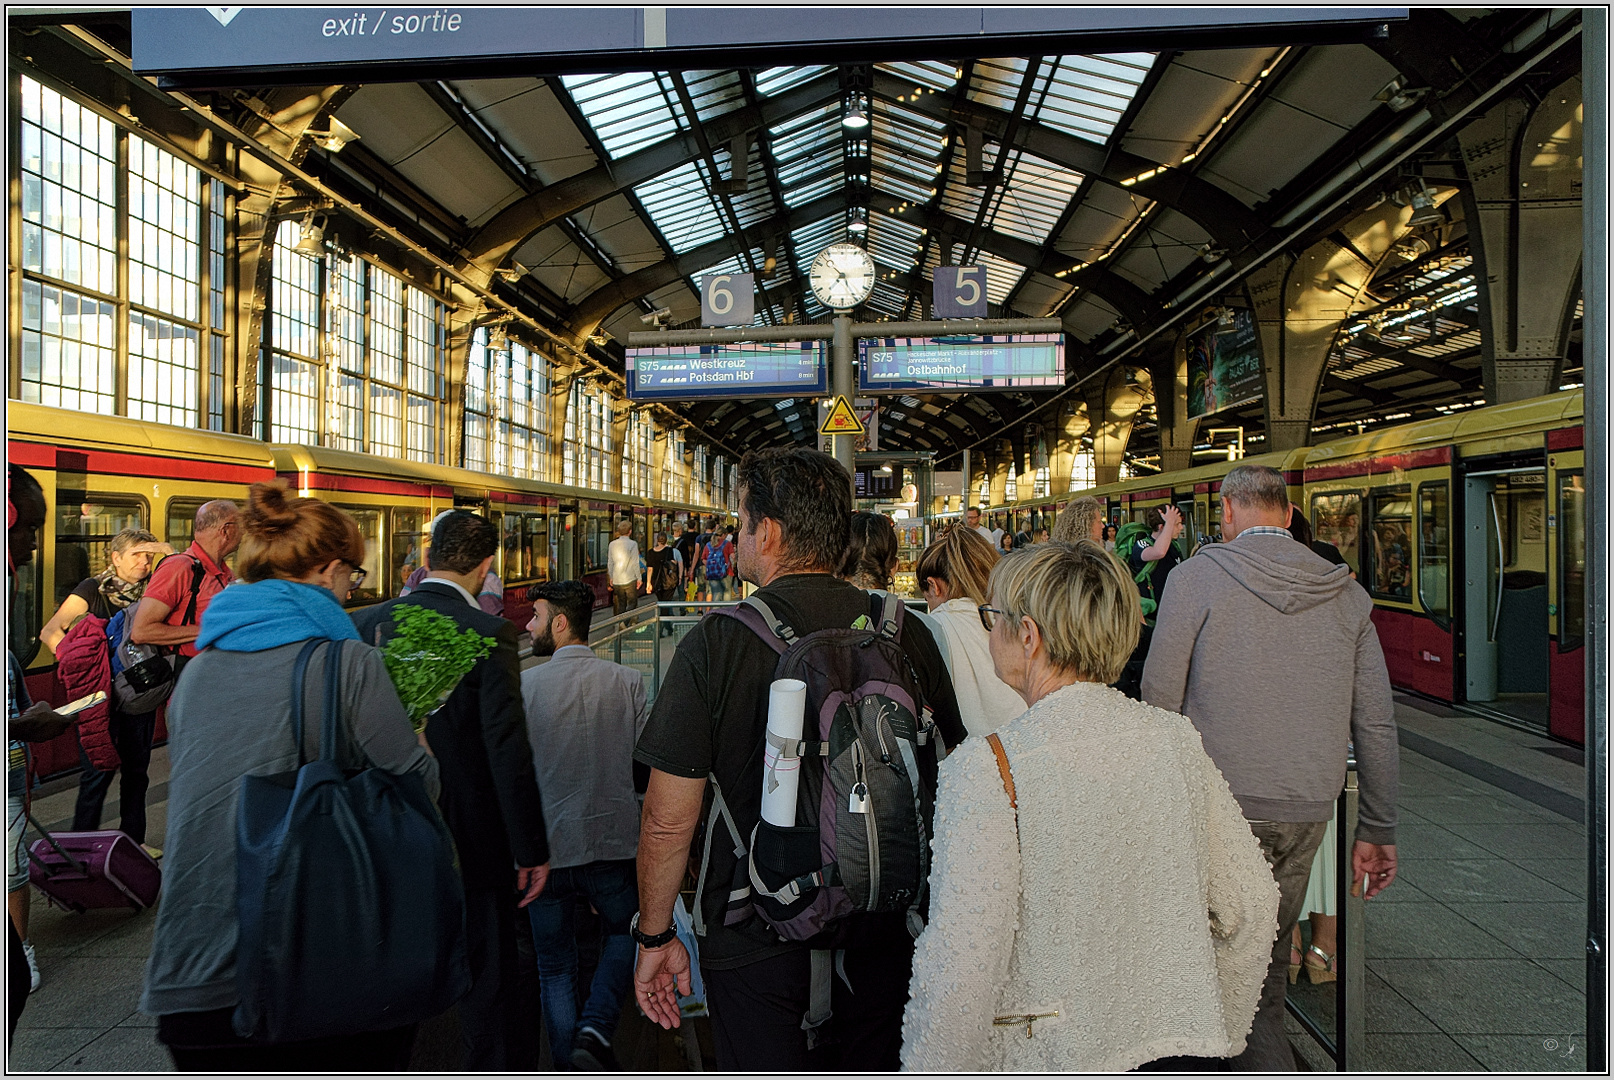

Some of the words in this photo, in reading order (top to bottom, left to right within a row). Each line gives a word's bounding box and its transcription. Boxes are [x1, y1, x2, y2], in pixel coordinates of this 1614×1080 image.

[322, 12, 368, 37] exit
[390, 9, 462, 34] sortie
[955, 267, 981, 306] 5
[708, 276, 734, 315] 6
[872, 353, 893, 362] S75
[639, 361, 659, 371] S75
[689, 359, 746, 370] Westkreuz
[907, 364, 966, 375] Ostbahnhof
[639, 374, 653, 384] S7
[689, 372, 734, 382] Potsdam
[736, 371, 754, 381] Hbf
